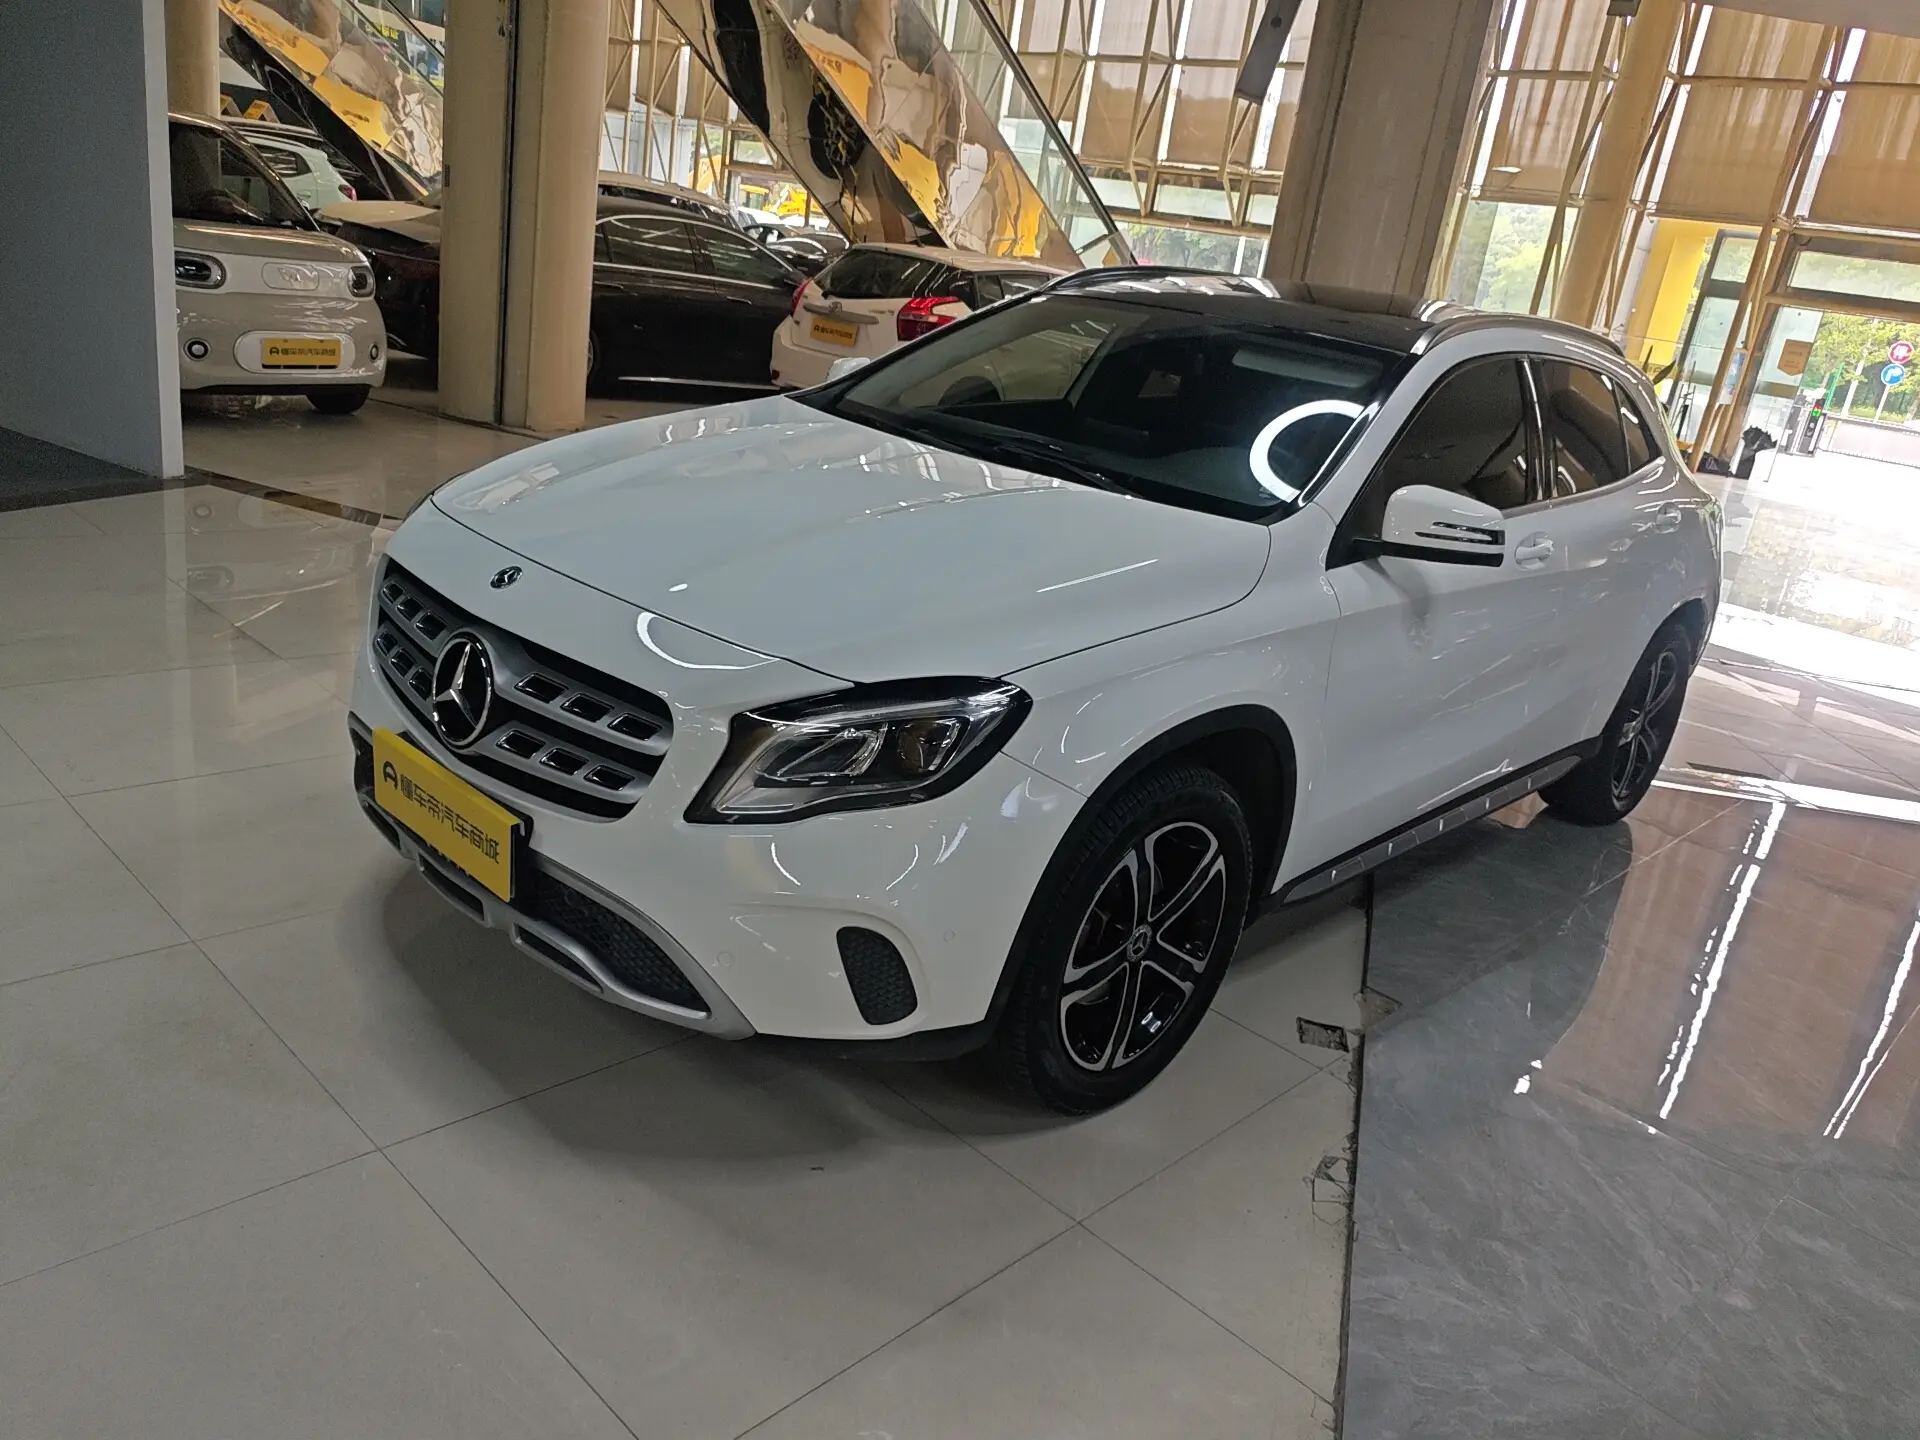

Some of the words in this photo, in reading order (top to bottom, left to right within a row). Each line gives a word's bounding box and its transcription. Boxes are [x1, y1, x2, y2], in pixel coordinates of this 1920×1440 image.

[400, 774, 500, 865] 懂车帝汽车商城
